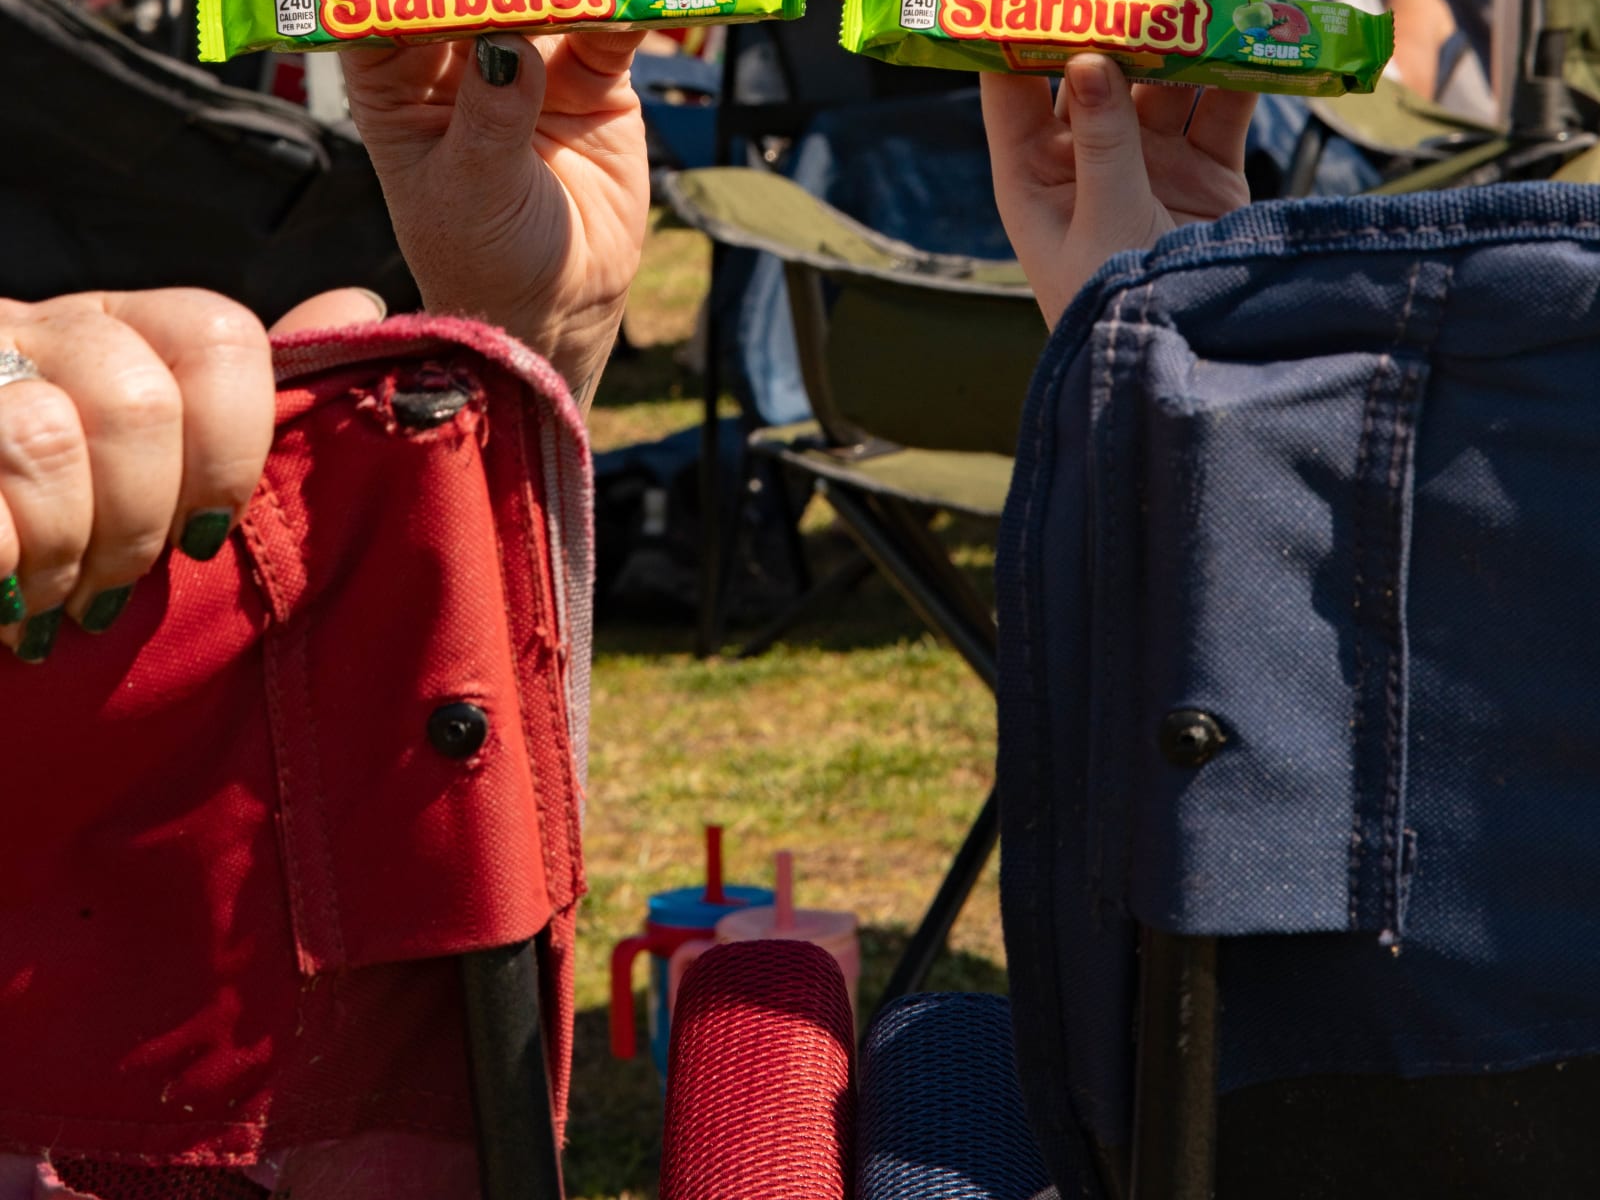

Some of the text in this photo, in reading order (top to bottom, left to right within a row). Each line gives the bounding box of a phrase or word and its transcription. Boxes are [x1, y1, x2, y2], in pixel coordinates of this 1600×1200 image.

[279, 10, 314, 22] CALORIES
[662, 6, 720, 17] FRUIT CHEWS
[903, 8, 933, 18] CALORIES
[282, 22, 312, 31] PER PACK
[904, 17, 931, 26] PER PACK
[1252, 43, 1300, 59] SOUR
[1248, 55, 1272, 65] FRUIT
